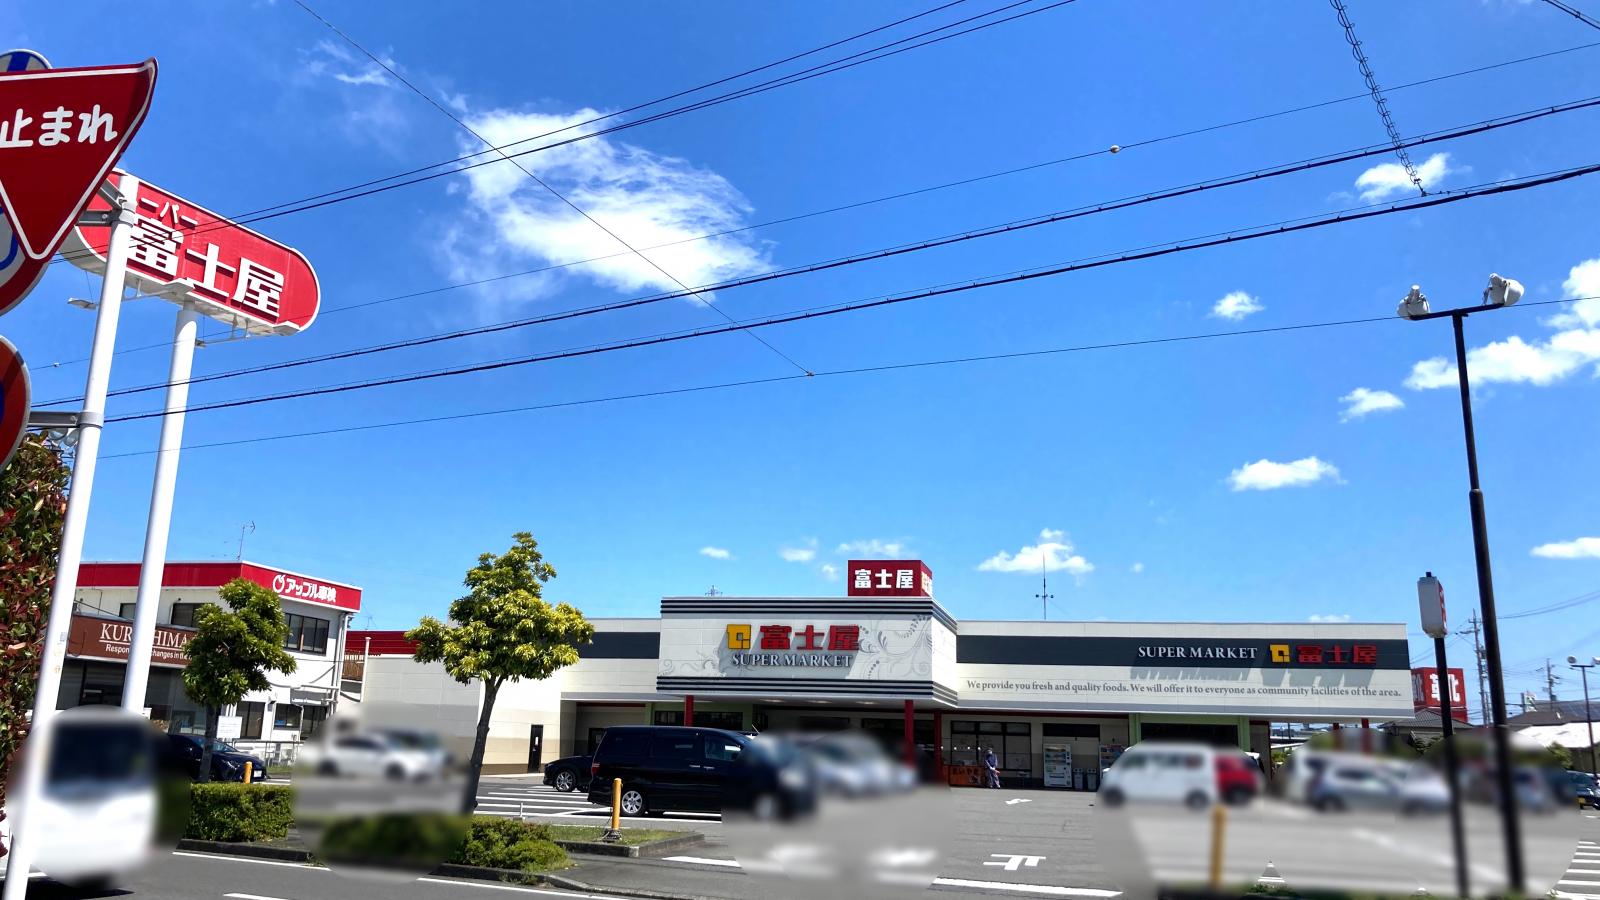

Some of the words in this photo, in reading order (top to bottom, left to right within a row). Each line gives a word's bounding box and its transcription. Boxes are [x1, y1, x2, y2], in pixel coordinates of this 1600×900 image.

[0, 104, 118, 148] 止まれ
[140, 197, 198, 225] ーパー
[126, 214, 285, 317] 富士屋
[854, 568, 914, 590] 富士屋
[99, 622, 187, 648] KURHIMA
[760, 624, 860, 651] 富士屋
[152, 649, 174, 660] hanges
[732, 653, 780, 667] SUPER
[784, 653, 852, 668] MARKET
[1138, 646, 1186, 658] SUPER
[1189, 647, 1258, 660] MARKET
[1296, 644, 1377, 664] 富士屋
[967, 680, 981, 689] We
[982, 680, 1014, 691] provide
[1015, 683, 1033, 691] you
[1033, 681, 1052, 690] fresh
[1054, 682, 1070, 691] and
[1072, 682, 1101, 693] quality
[1103, 683, 1129, 692] foods.
[1130, 683, 1145, 692] We
[1146, 684, 1162, 693] will
[1164, 684, 1185, 693] offer
[1186, 685, 1192, 693] it
[1205, 687, 1245, 696] everyone
[1257, 686, 1308, 697] community
[1311, 686, 1349, 695] facilities
[1351, 686, 1362, 696] of
[1362, 687, 1377, 696] the
[1378, 689, 1401, 697] area.
